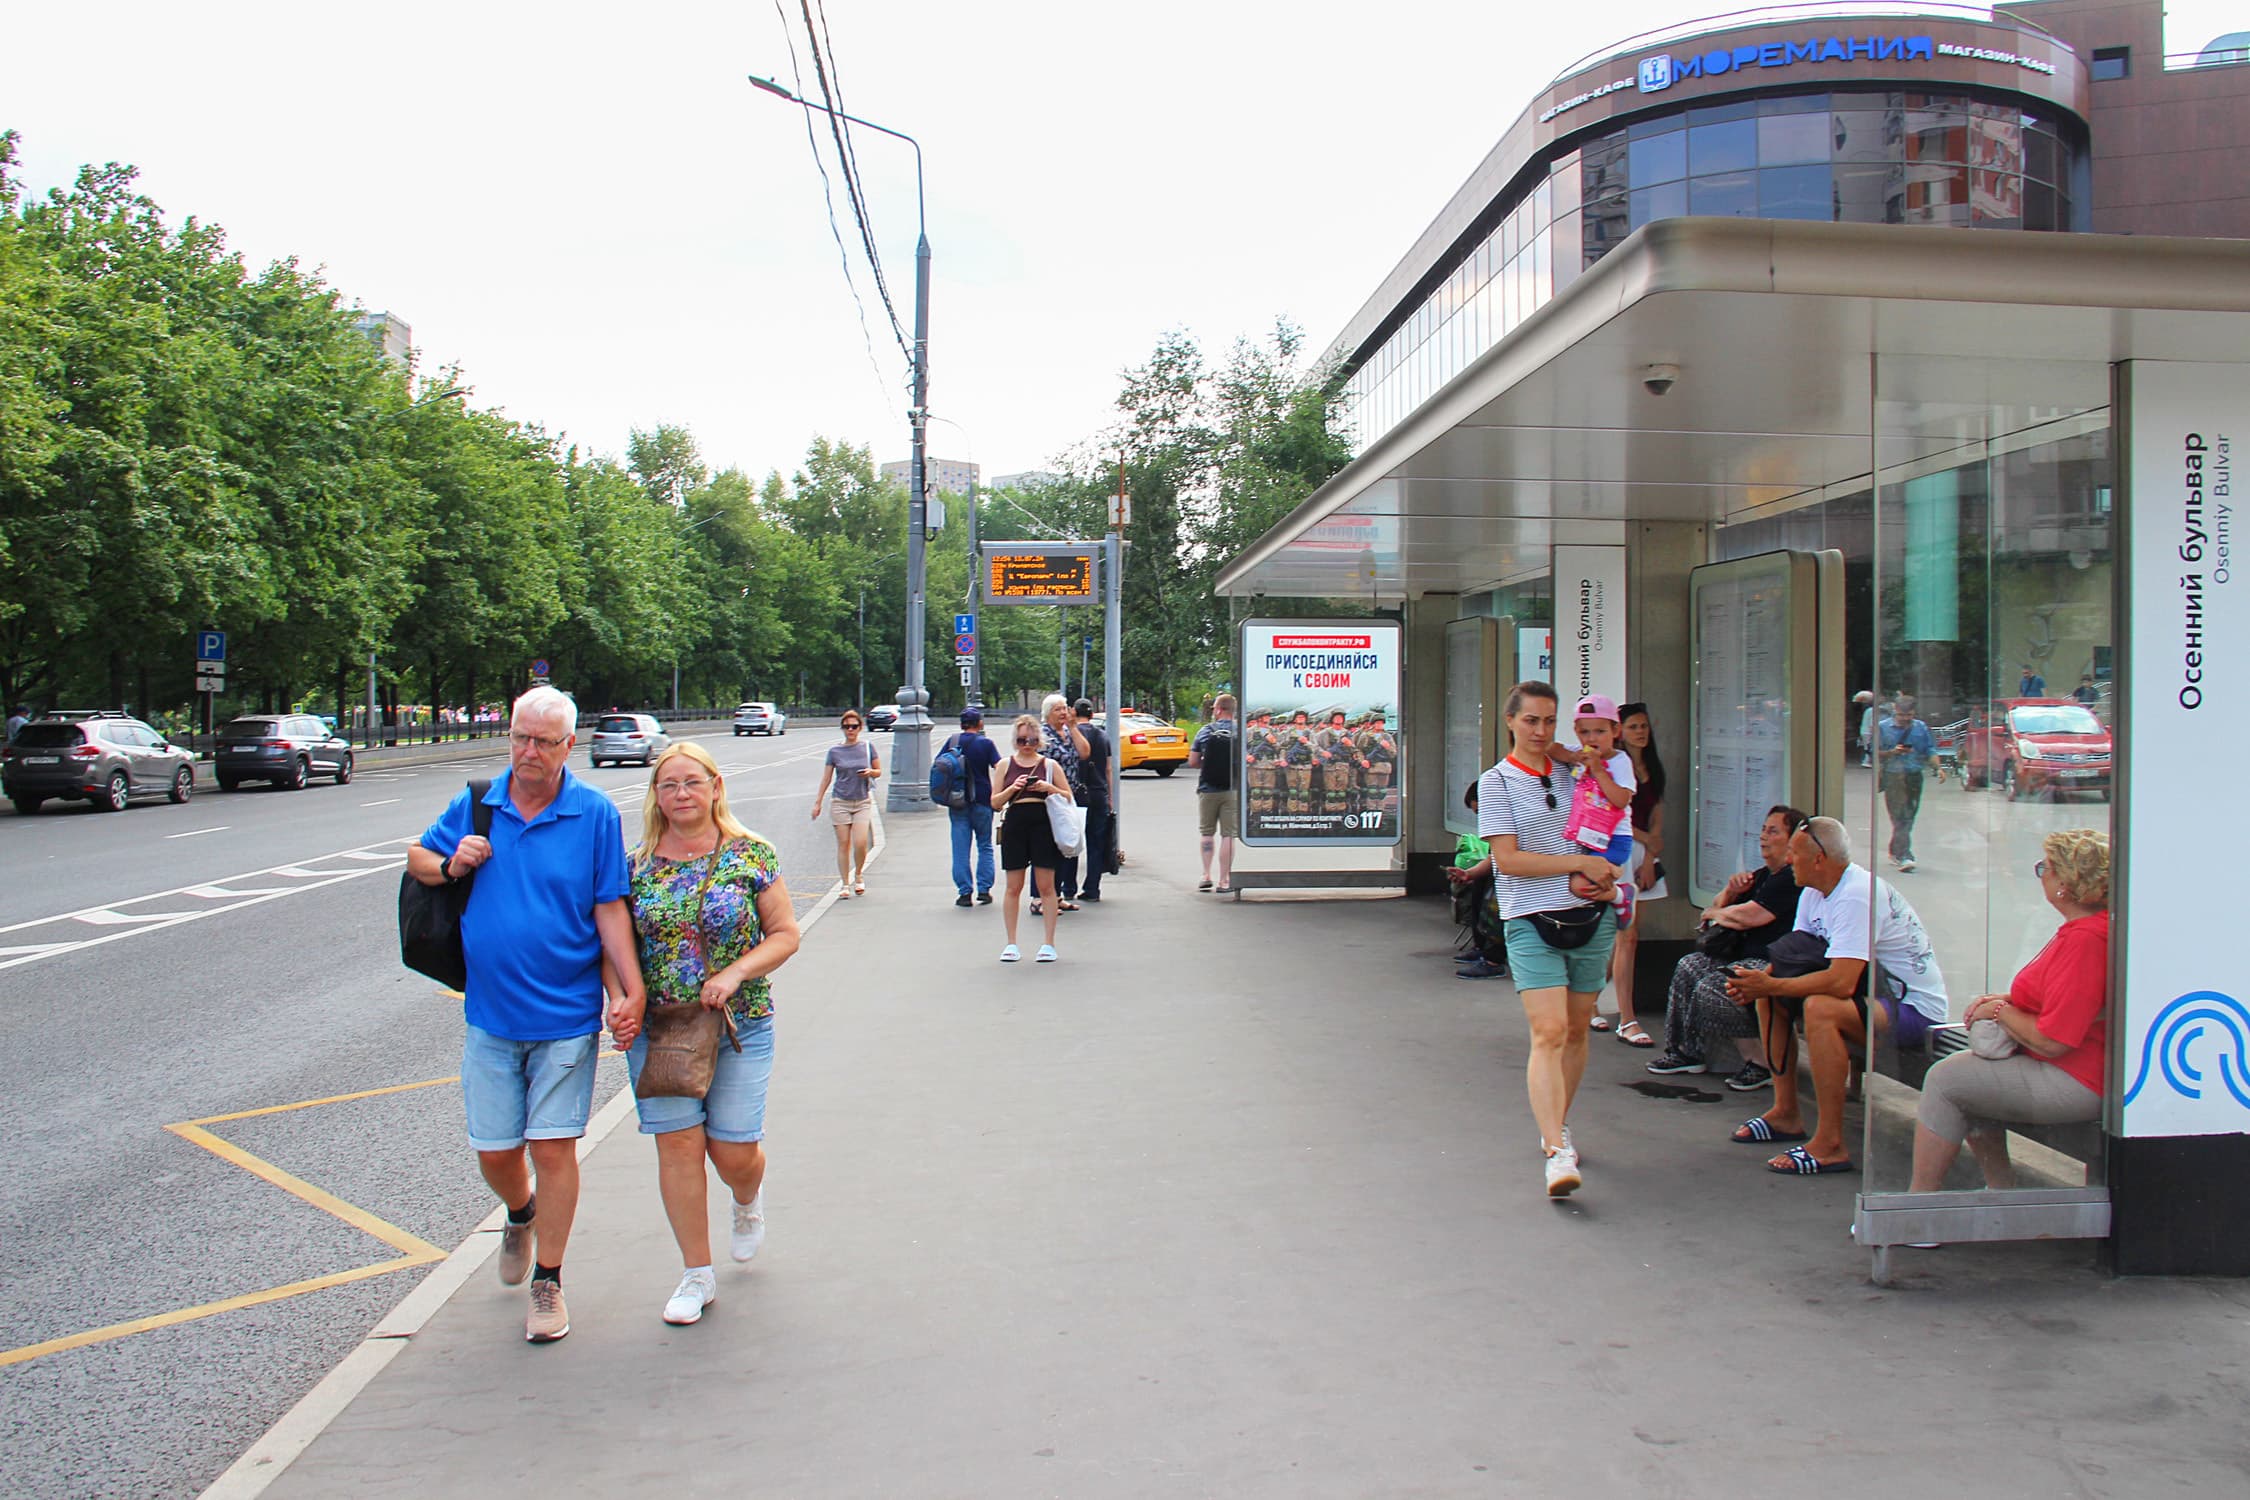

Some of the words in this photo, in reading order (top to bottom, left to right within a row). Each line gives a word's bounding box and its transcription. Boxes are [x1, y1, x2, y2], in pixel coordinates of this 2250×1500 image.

[1672, 35, 1932, 83] МОРЕМАНИЯ
[1937, 43, 2057, 75] МАГАЗИН-КАФЕ
[2214, 433, 2231, 498] Bulvar
[2178, 432, 2208, 563] бульвар
[2214, 504, 2233, 584] Osenniy
[1577, 579, 1592, 640] бульвар
[1265, 651, 1378, 671] ПРИСОЕДИНЯЙСЯ
[2178, 573, 2204, 711] Осенний
[1293, 673, 1302, 688] К
[1305, 673, 1351, 688] СВОИМ
[1360, 811, 1383, 829] 117
